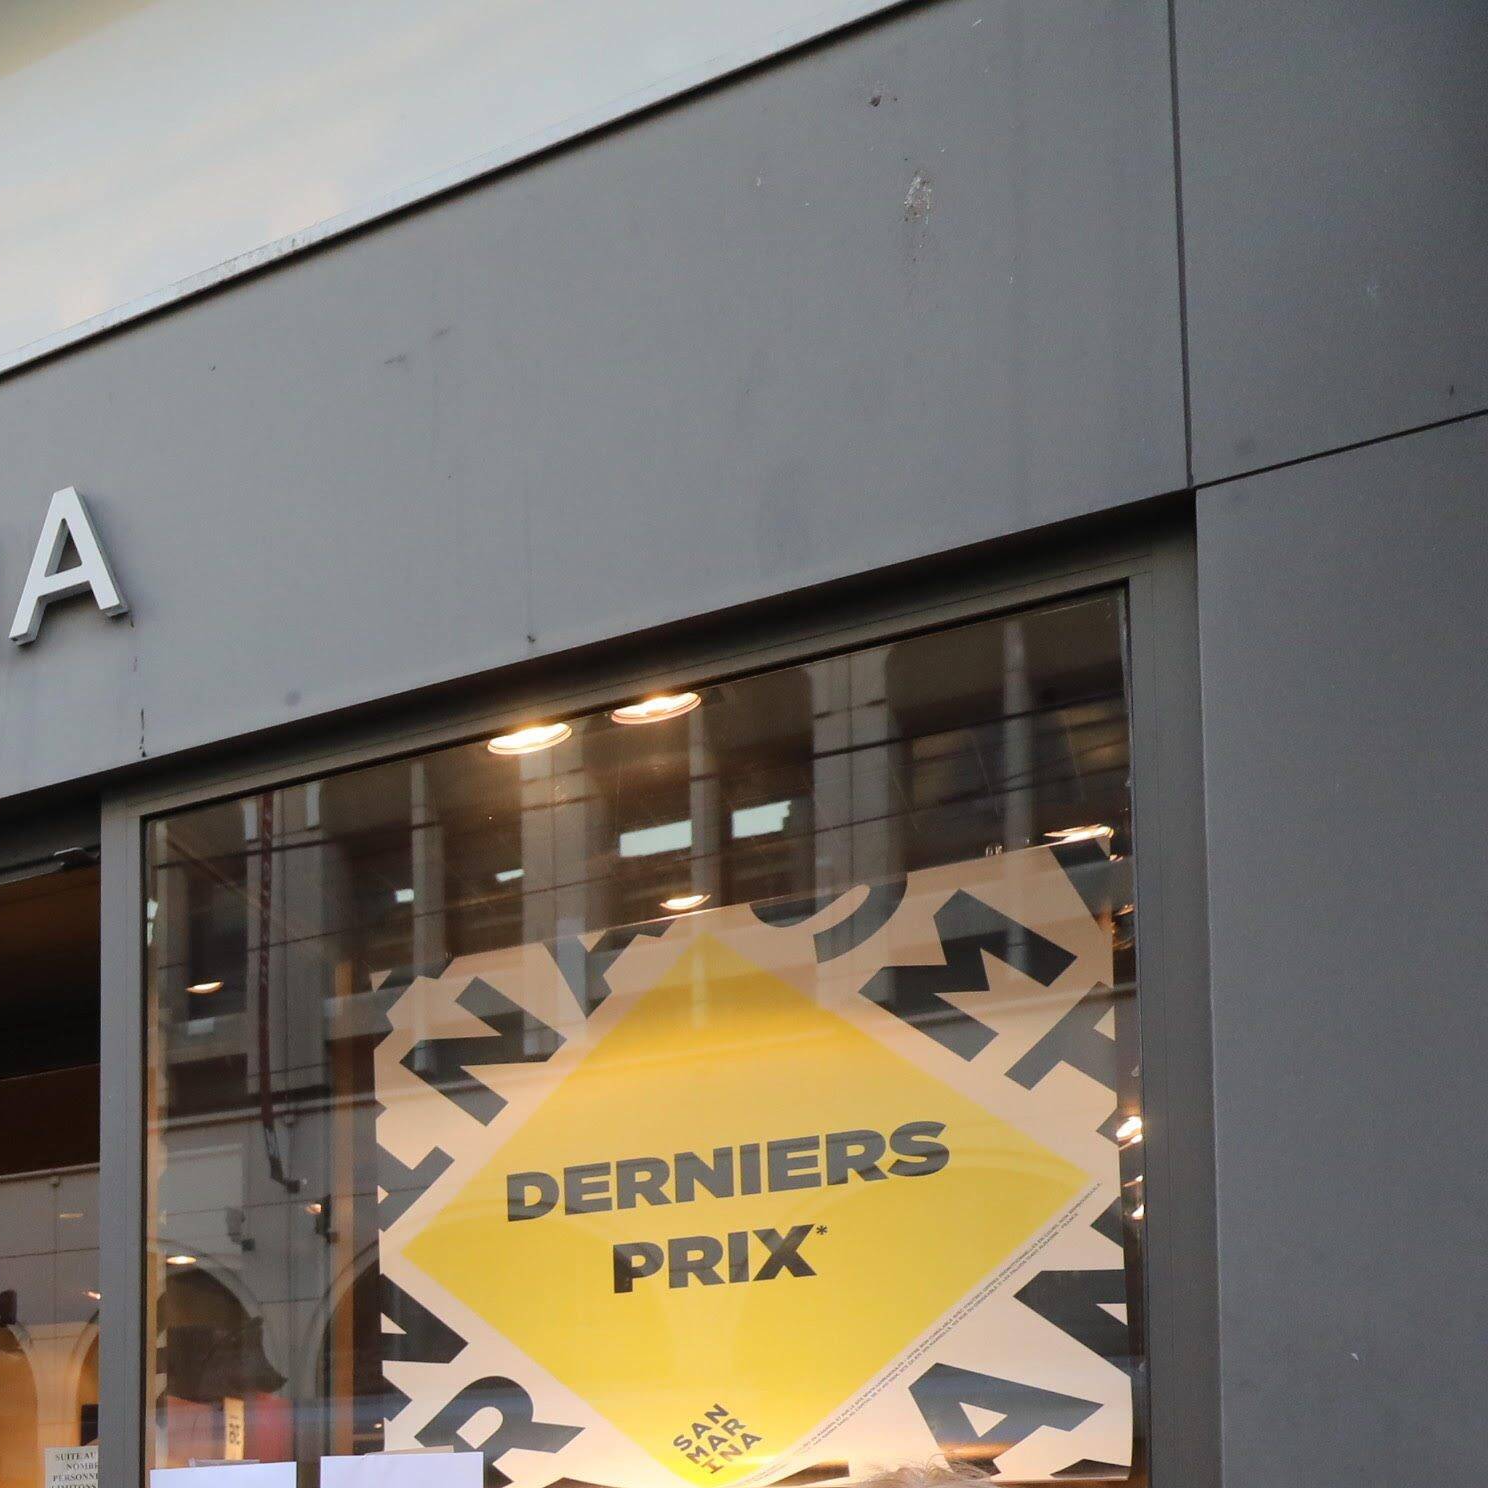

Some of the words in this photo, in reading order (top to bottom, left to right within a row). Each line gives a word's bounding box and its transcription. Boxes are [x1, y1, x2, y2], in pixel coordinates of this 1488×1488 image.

[506, 1121, 950, 1222] DERNIERS
[672, 1402, 730, 1452] SAN
[685, 1417, 746, 1465] MAR
[56, 1452, 81, 1461] SUITE
[701, 1431, 763, 1475] INA
